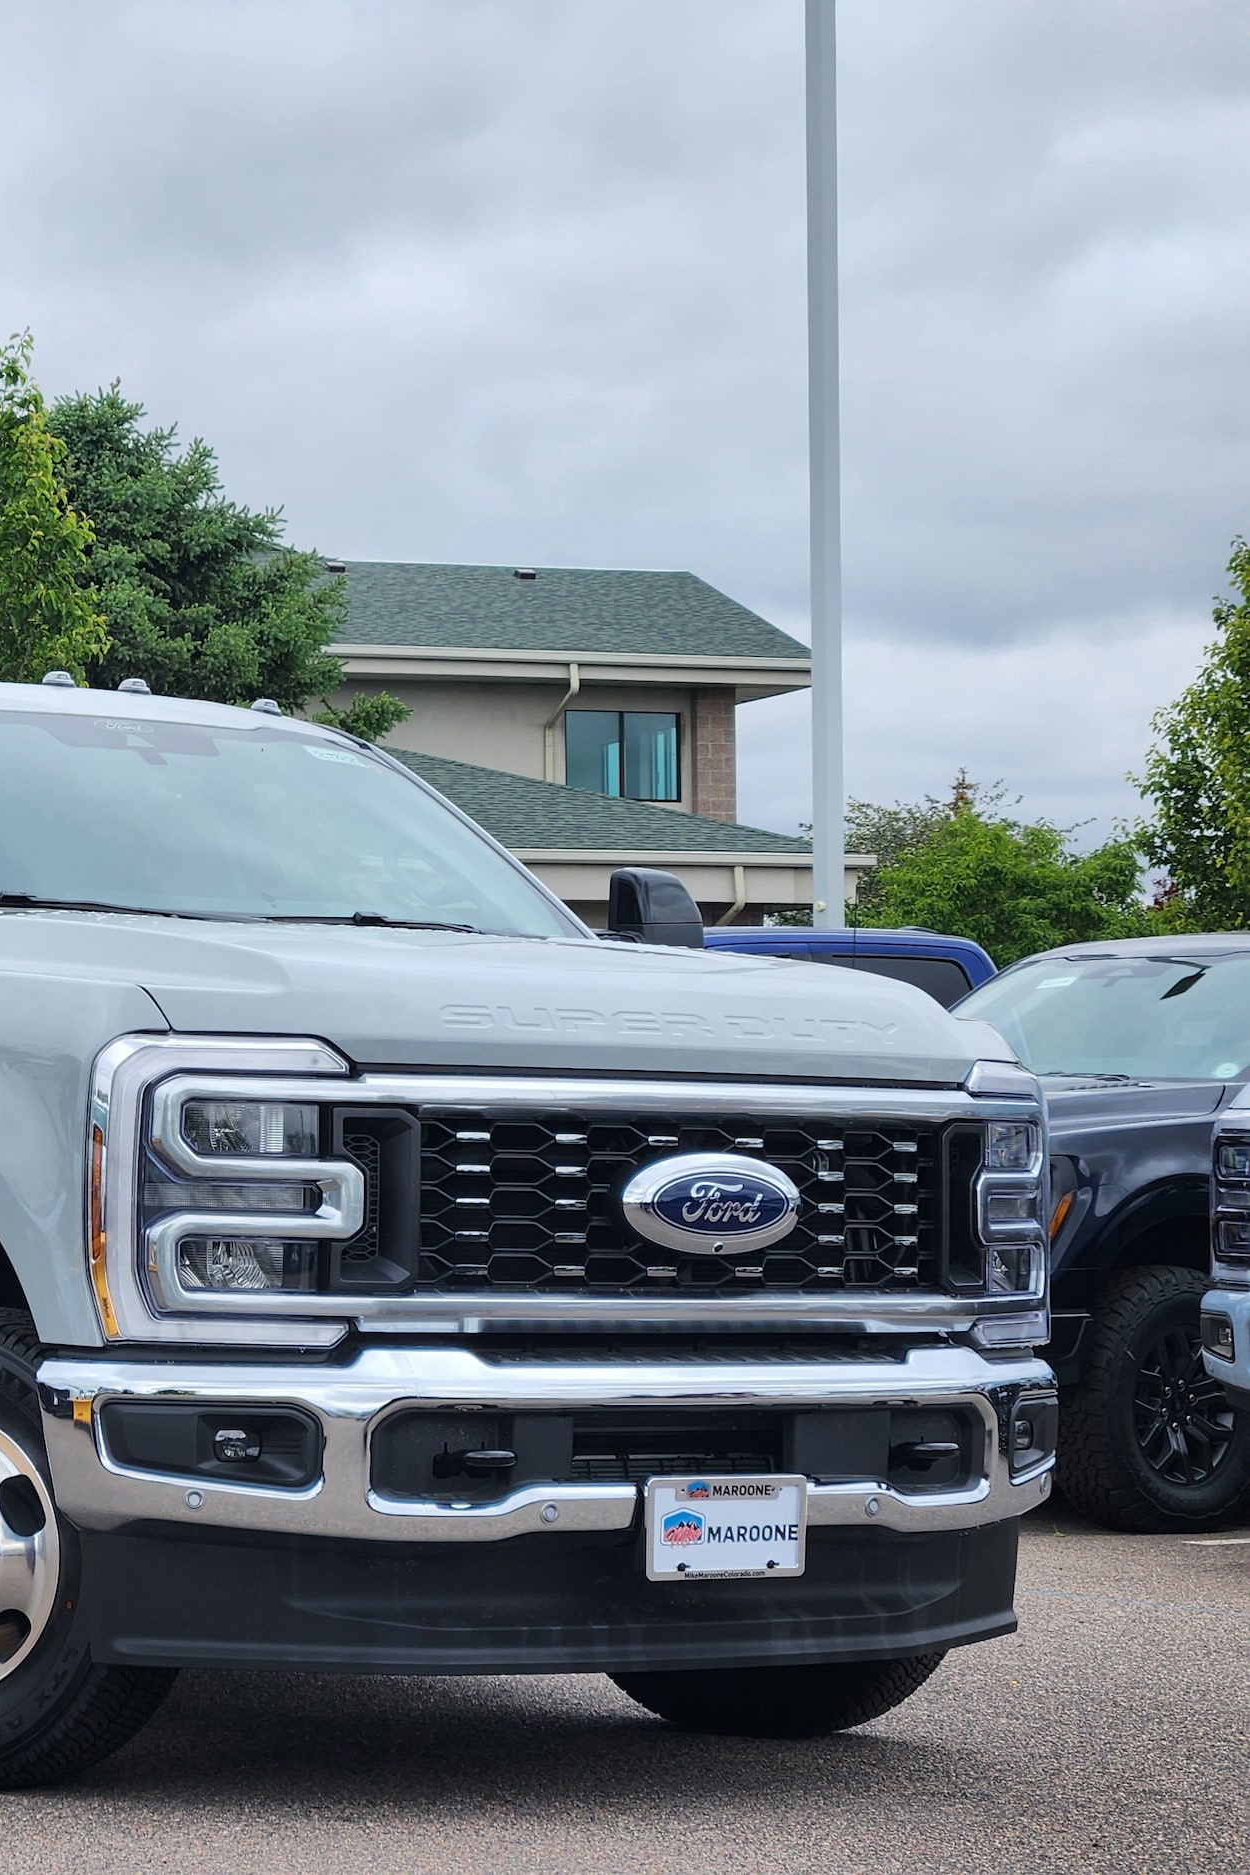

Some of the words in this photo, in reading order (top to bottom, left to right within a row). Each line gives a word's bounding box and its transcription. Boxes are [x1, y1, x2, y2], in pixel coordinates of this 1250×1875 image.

[439, 1004, 715, 1037] SUPER
[723, 1015, 899, 1044] DUTY
[682, 1181, 764, 1223] Ford
[712, 1484, 771, 1497] MAROONE
[707, 1524, 799, 1544] MAROONE
[684, 1570, 766, 1580] MikeMarooneColorado.com
